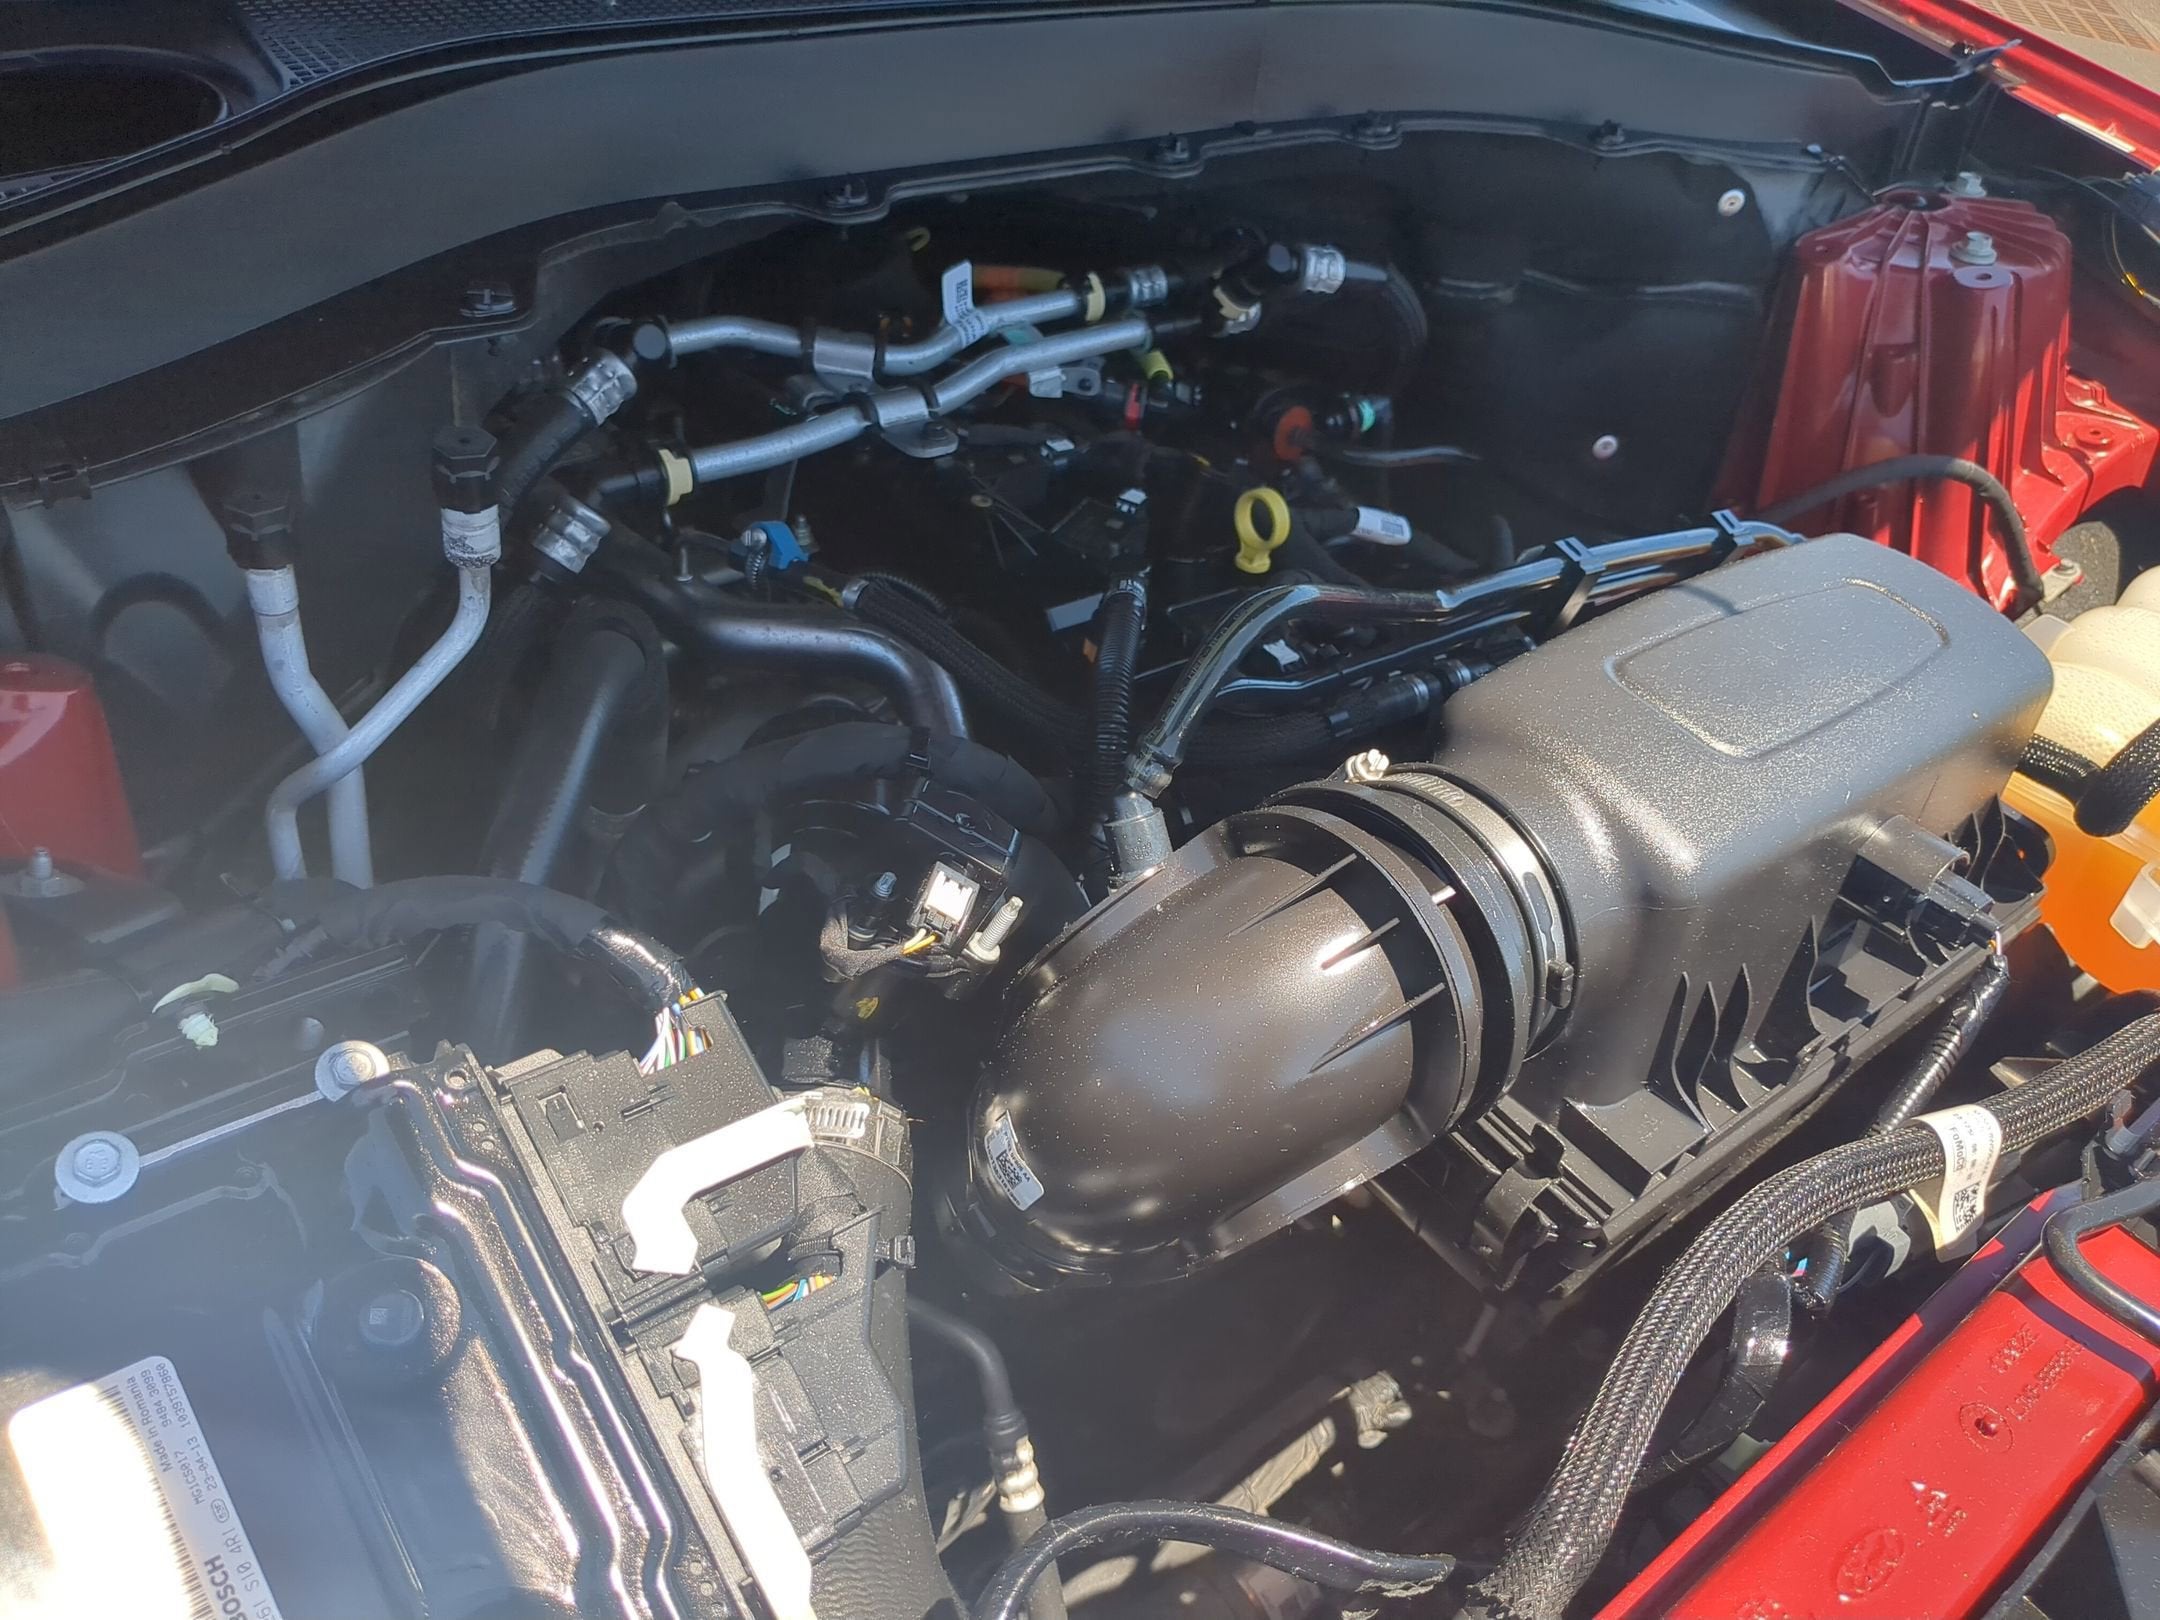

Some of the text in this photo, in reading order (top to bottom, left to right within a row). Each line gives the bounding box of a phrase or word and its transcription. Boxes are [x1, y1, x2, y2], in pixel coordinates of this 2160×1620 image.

[127, 1376, 174, 1473] Made in Romania
[187, 1436, 218, 1491] 23-04-13
